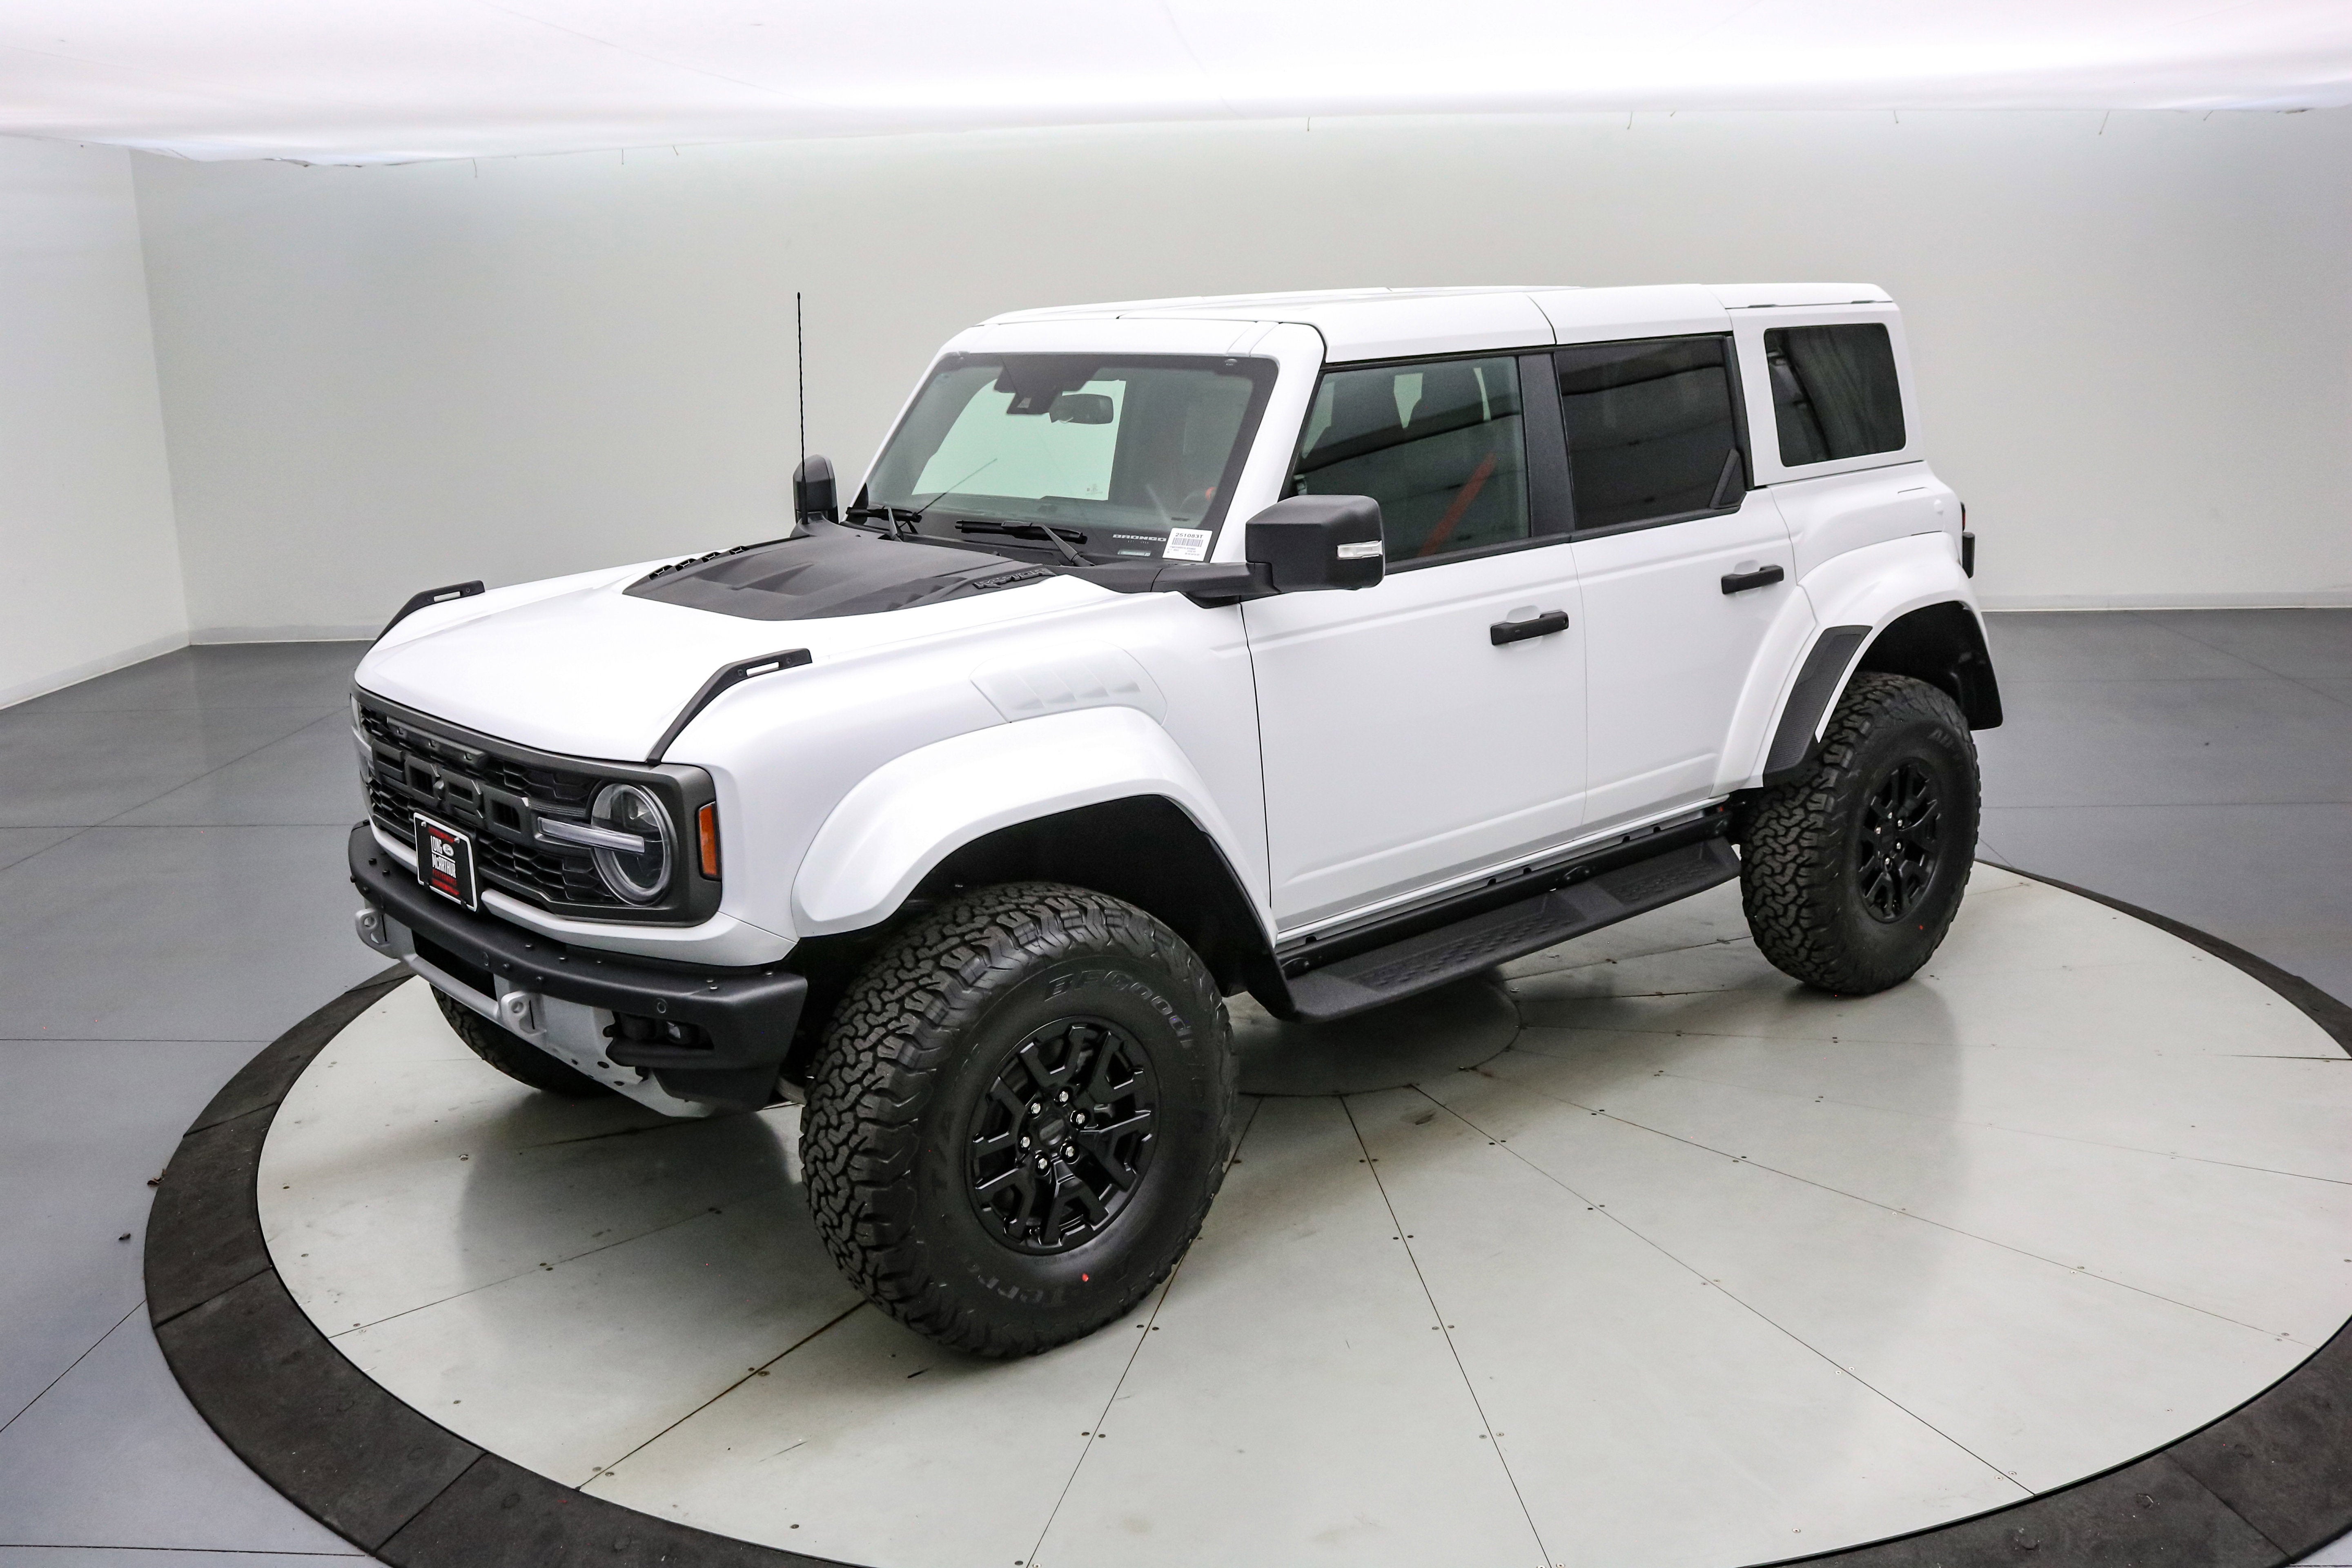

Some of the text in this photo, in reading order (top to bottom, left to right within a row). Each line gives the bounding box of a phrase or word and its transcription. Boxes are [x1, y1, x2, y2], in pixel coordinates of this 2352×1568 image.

[1112, 534, 1167, 542] BRONCO
[972, 568, 1057, 590] RAPTOR
[430, 835, 443, 855] LONG
[432, 853, 457, 879] McARTHUR
